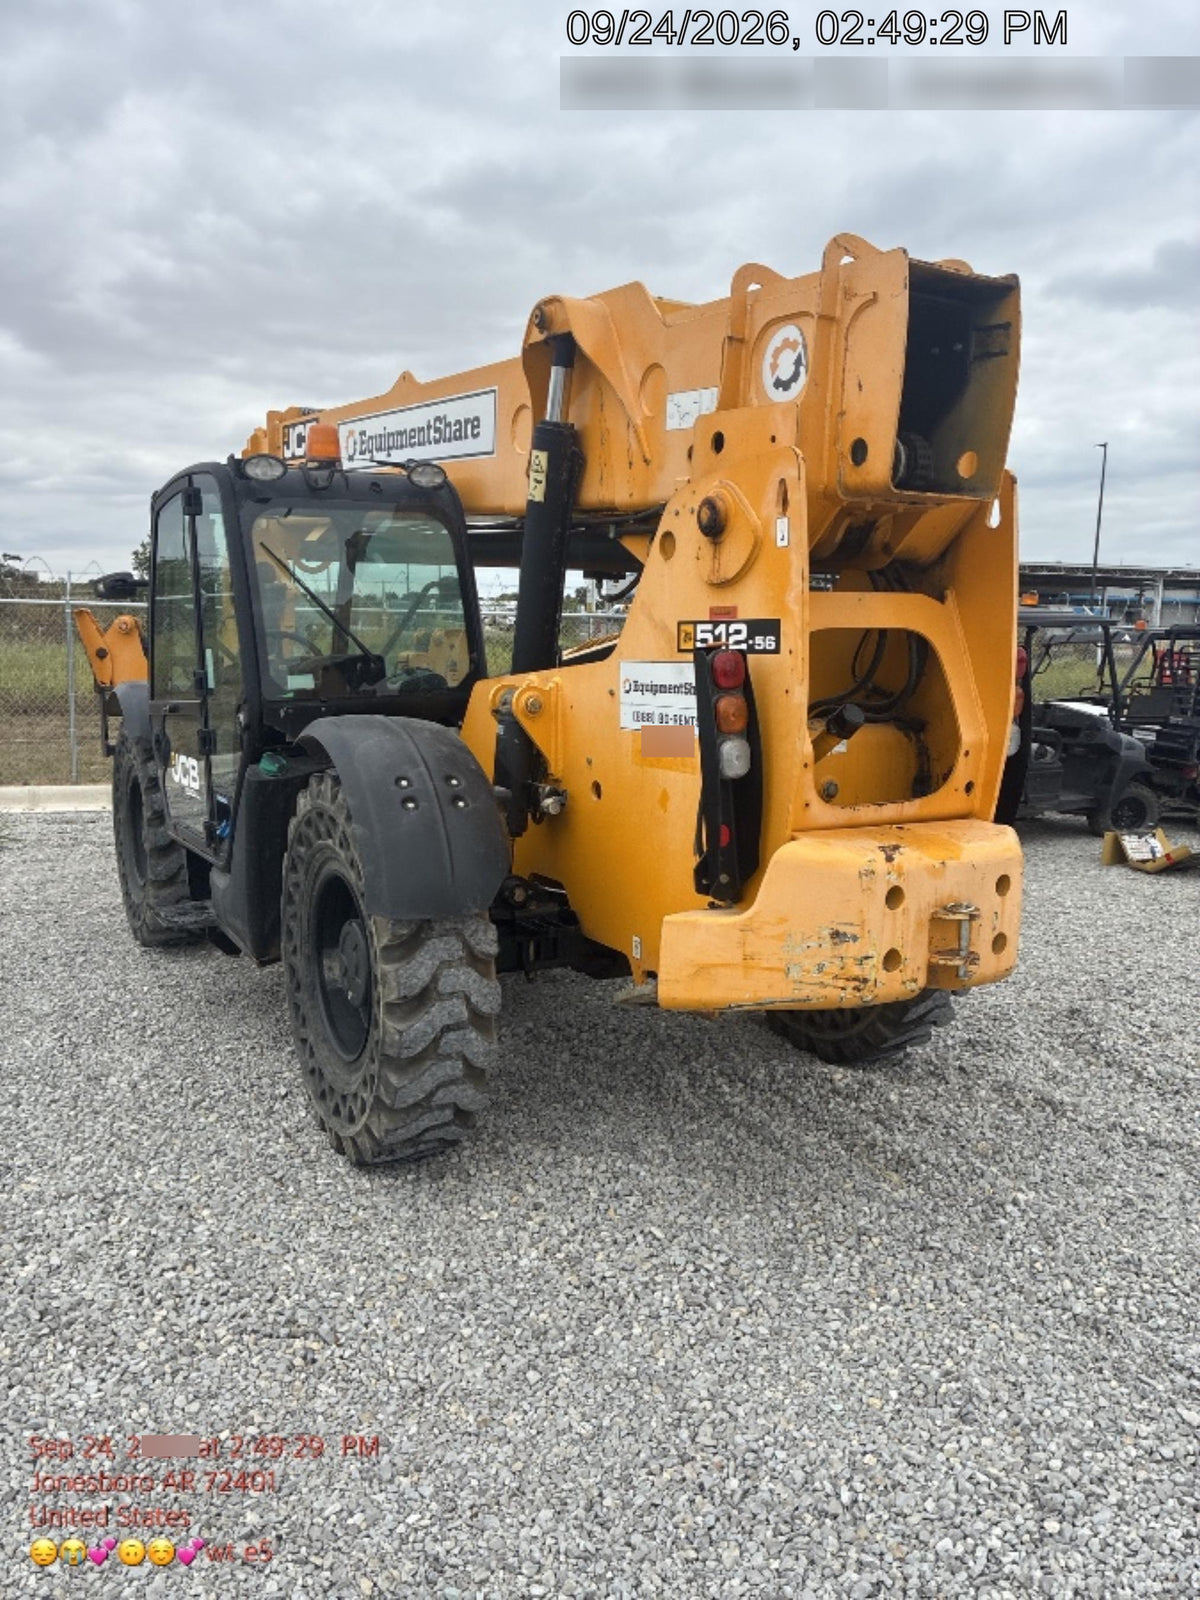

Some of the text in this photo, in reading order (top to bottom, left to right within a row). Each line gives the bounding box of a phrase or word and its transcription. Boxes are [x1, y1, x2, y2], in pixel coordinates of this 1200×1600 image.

[283, 421, 312, 458] JC
[359, 415, 481, 459] EquipmentShare
[633, 680, 697, 695] EquipmentSh
[172, 755, 199, 789] JCB
